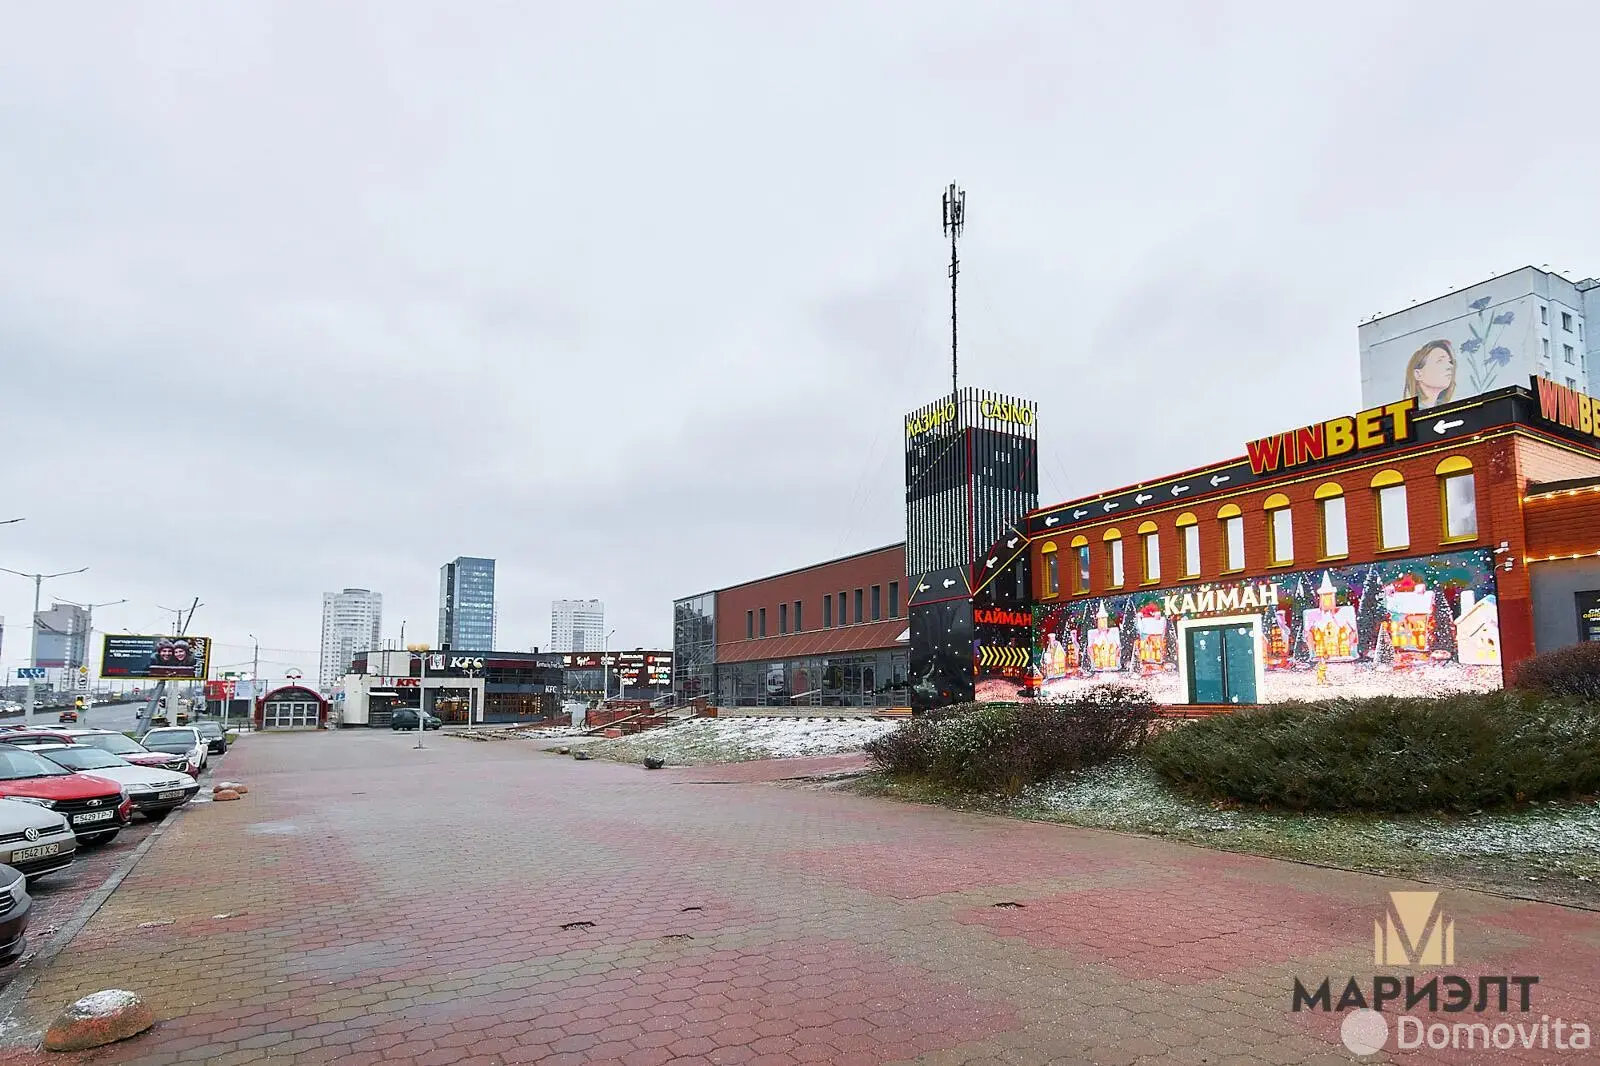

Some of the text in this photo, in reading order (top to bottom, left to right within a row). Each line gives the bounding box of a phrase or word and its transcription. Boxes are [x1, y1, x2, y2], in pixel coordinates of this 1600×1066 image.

[907, 402, 956, 437] КАЗИНО
[981, 399, 1033, 426] CASINO
[1246, 398, 1415, 475] WINBET
[1160, 582, 1283, 616] КАЙМАН
[974, 607, 1032, 626] КАЙМАН
[449, 656, 484, 668] KFC
[396, 678, 421, 687] KFC
[545, 685, 557, 693] KFC
[79, 814, 96, 822] 5429
[20, 847, 38, 859] 1542
